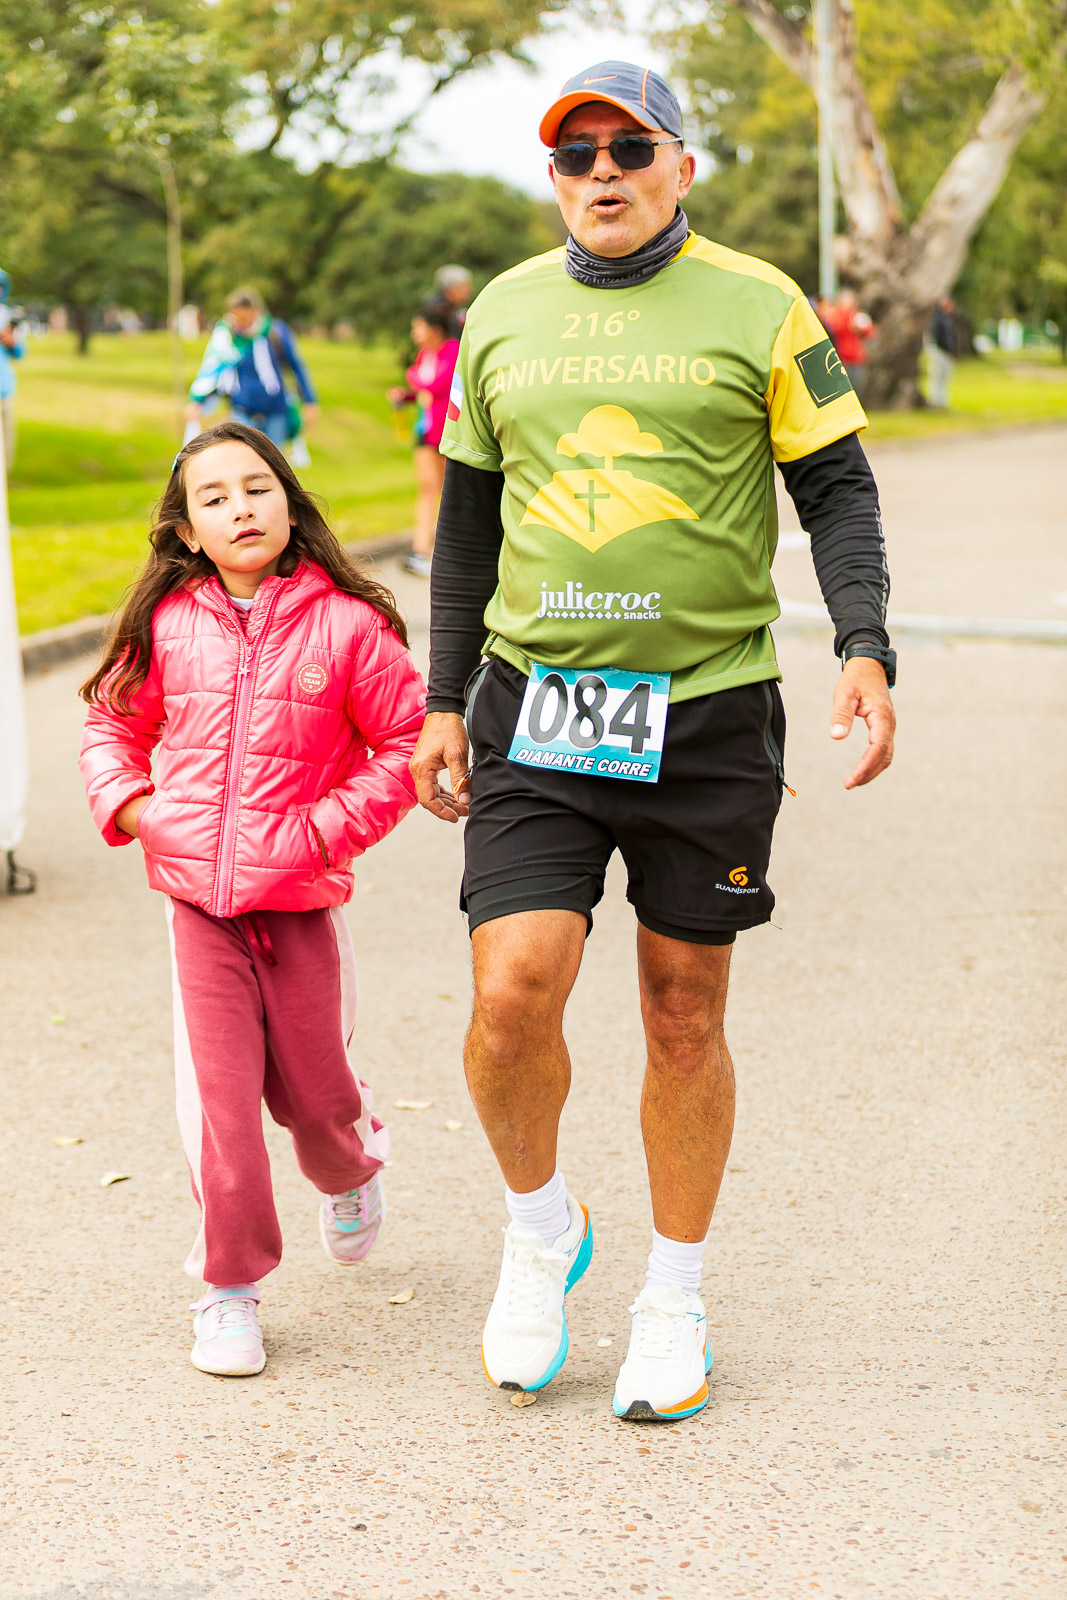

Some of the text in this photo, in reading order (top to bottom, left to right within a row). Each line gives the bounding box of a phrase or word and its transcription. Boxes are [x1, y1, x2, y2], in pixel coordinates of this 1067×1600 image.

[492, 354, 716, 397] ANIVERSARIO
[536, 581, 661, 620] julicroc
[623, 610, 662, 620] snacks
[303, 677, 321, 685] TEAM
[527, 671, 652, 756] 084
[515, 748, 653, 778] DIAMANTE CORRE
